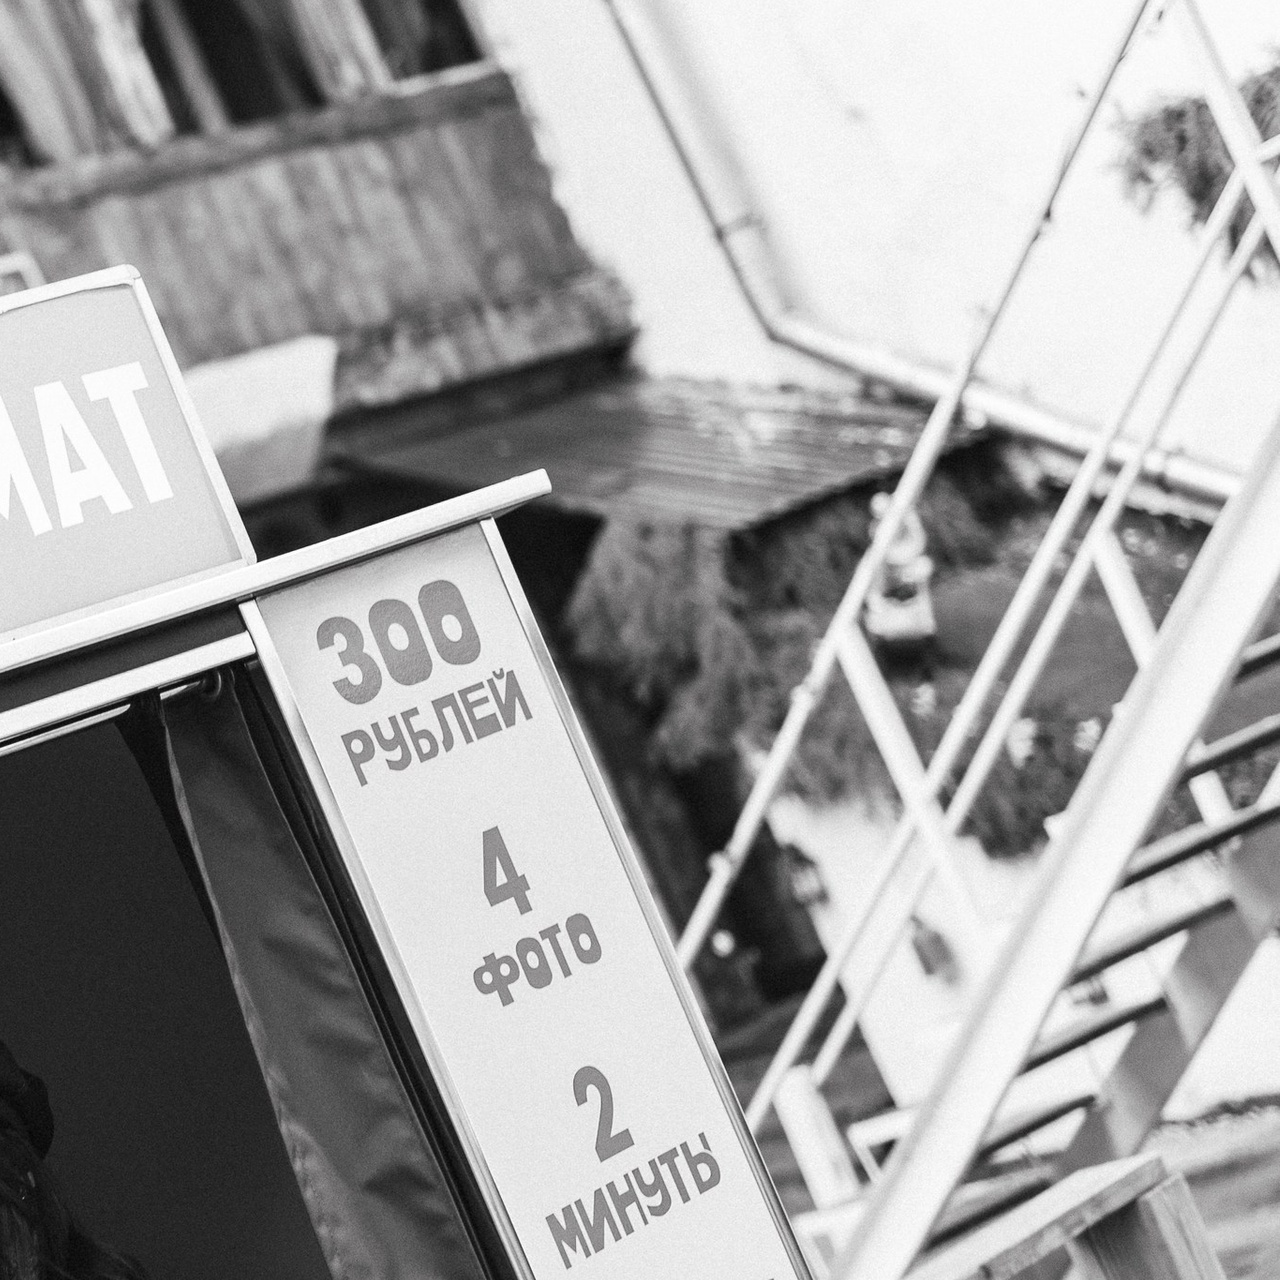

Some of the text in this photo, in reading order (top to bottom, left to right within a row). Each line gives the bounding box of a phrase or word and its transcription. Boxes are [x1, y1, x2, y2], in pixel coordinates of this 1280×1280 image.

[316, 580, 482, 705] 300
[340, 668, 533, 787] РУБЛЕЙ
[481, 825, 533, 916] 4
[472, 913, 602, 1007] ФОТО
[572, 1066, 636, 1163] 2
[545, 1131, 721, 1270] МИНУТЫ
